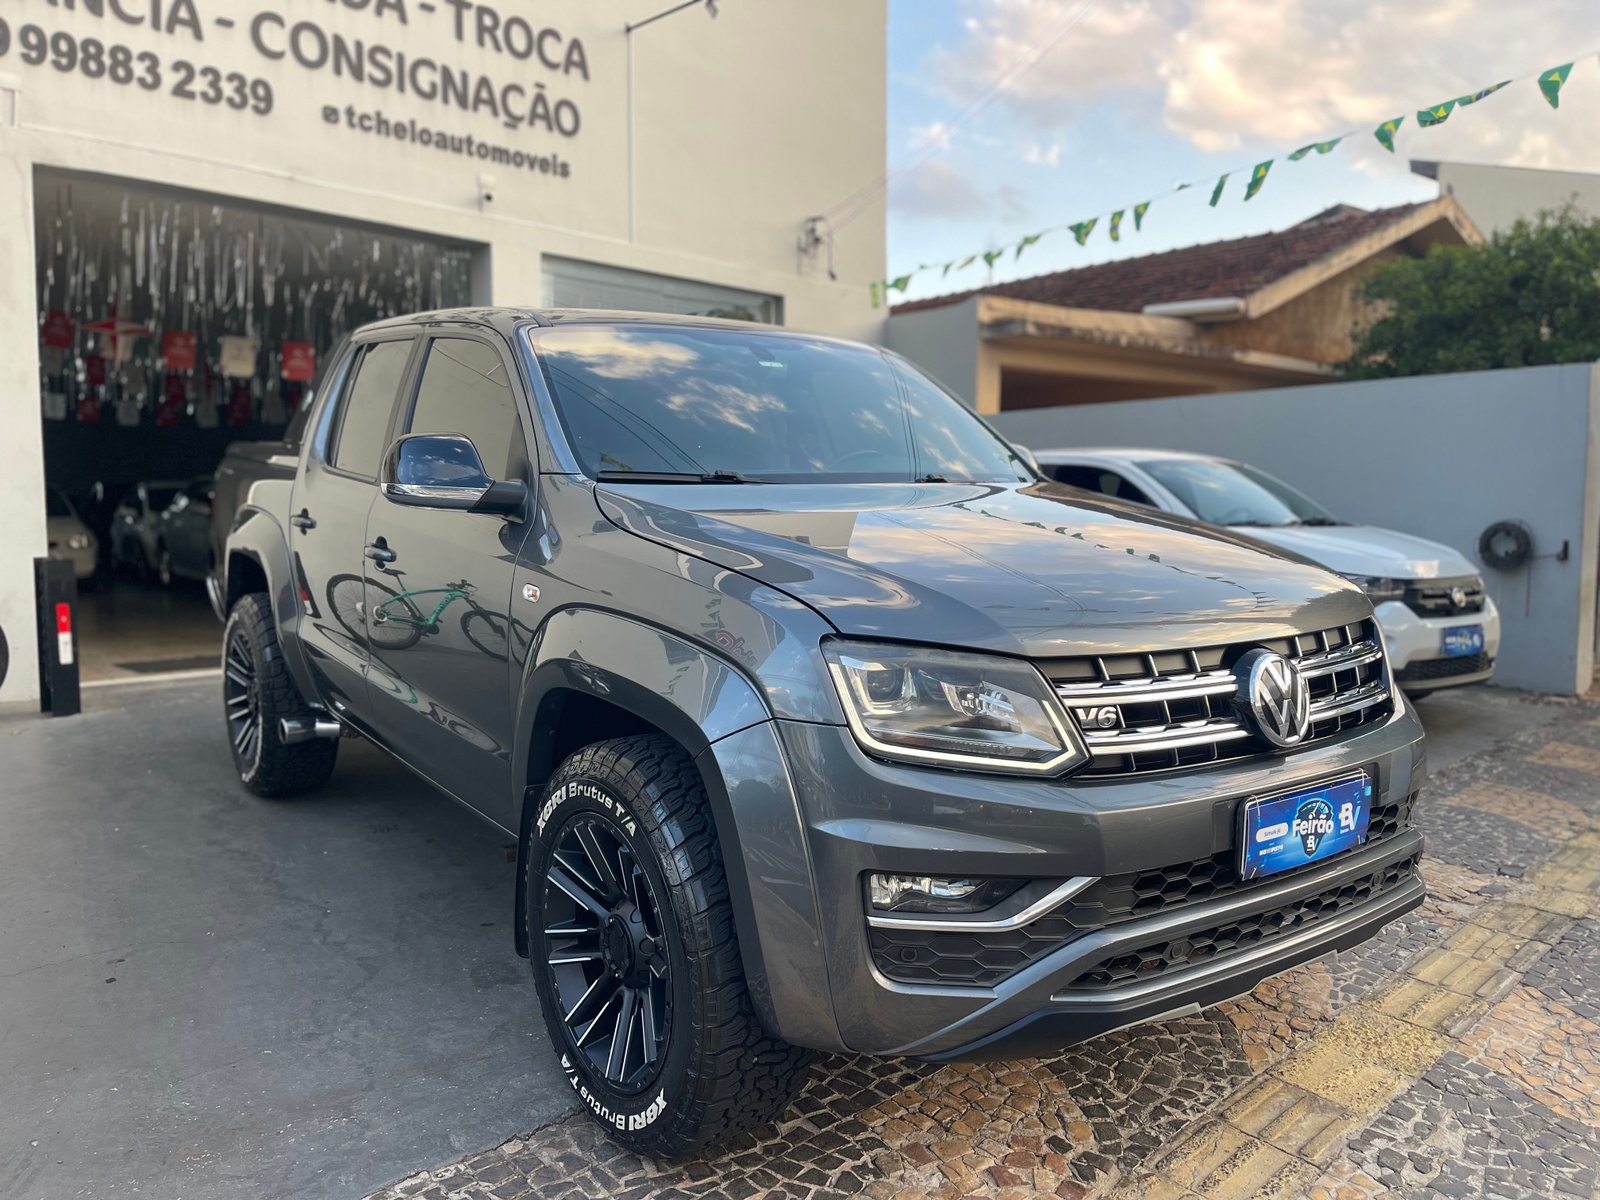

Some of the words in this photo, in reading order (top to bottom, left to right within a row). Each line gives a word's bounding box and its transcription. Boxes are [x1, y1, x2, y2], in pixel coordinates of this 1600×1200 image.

[444, 0, 591, 82] TROCA
[18, 23, 163, 92] 99883
[171, 59, 274, 117] 2339
[250, 11, 582, 138] CONSIGNAÇÃO
[1074, 705, 1118, 729] V6
[568, 782, 614, 810] Brutus
[1292, 813, 1335, 838] Feirão
[580, 1086, 626, 1131] Brutus
